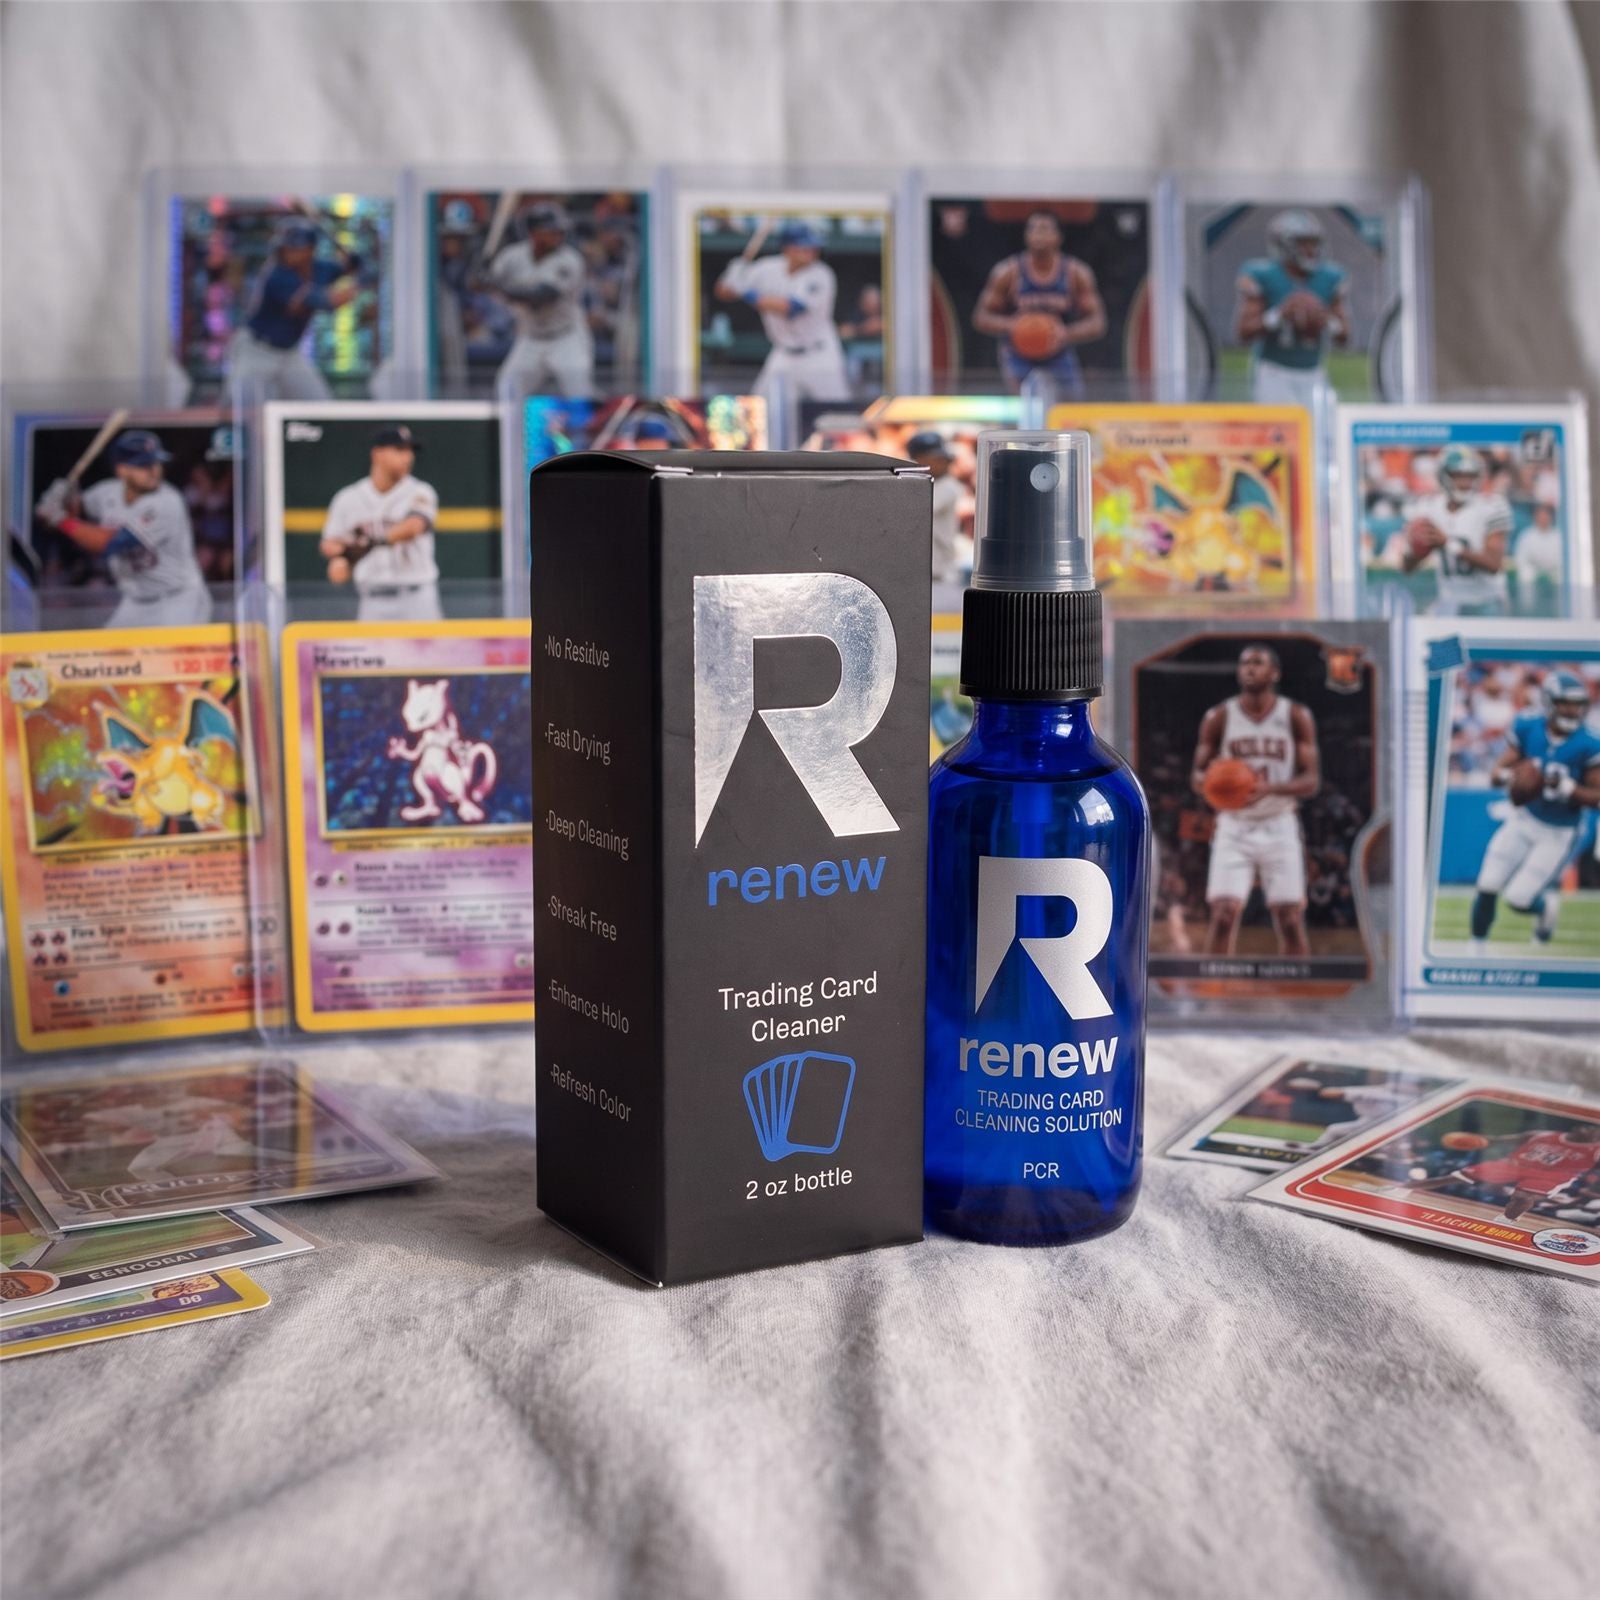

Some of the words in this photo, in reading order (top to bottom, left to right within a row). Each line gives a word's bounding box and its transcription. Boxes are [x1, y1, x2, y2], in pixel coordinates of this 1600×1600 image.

[548, 634, 561, 658] No
[60, 663, 142, 680] Charizard
[693, 571, 901, 849] R
[547, 722, 571, 750] Fast
[572, 729, 611, 766] Drying
[548, 809, 576, 841] Deep
[578, 819, 629, 861] Cleaning
[707, 856, 887, 906] renew
[550, 895, 588, 930] Streak
[589, 911, 618, 941] Free
[973, 855, 1115, 1020] R
[551, 978, 599, 1020] Enhance
[601, 1002, 630, 1034] Holo
[718, 982, 814, 1011] Trading
[820, 970, 878, 999] Card
[751, 1014, 846, 1042] Cleaner
[958, 1036, 1119, 1078] renew
[552, 1063, 597, 1105] Refresh
[599, 1088, 632, 1122] Color
[977, 1089, 1054, 1110] TRADING
[1059, 1089, 1104, 1110] CARD
[954, 1108, 1040, 1133] CLEANING
[1044, 1107, 1123, 1133] SOLUTION
[745, 1180, 758, 1200] 2
[764, 1179, 788, 1197] oz
[794, 1167, 853, 1193] bottle
[1022, 1162, 1060, 1179] PCR
